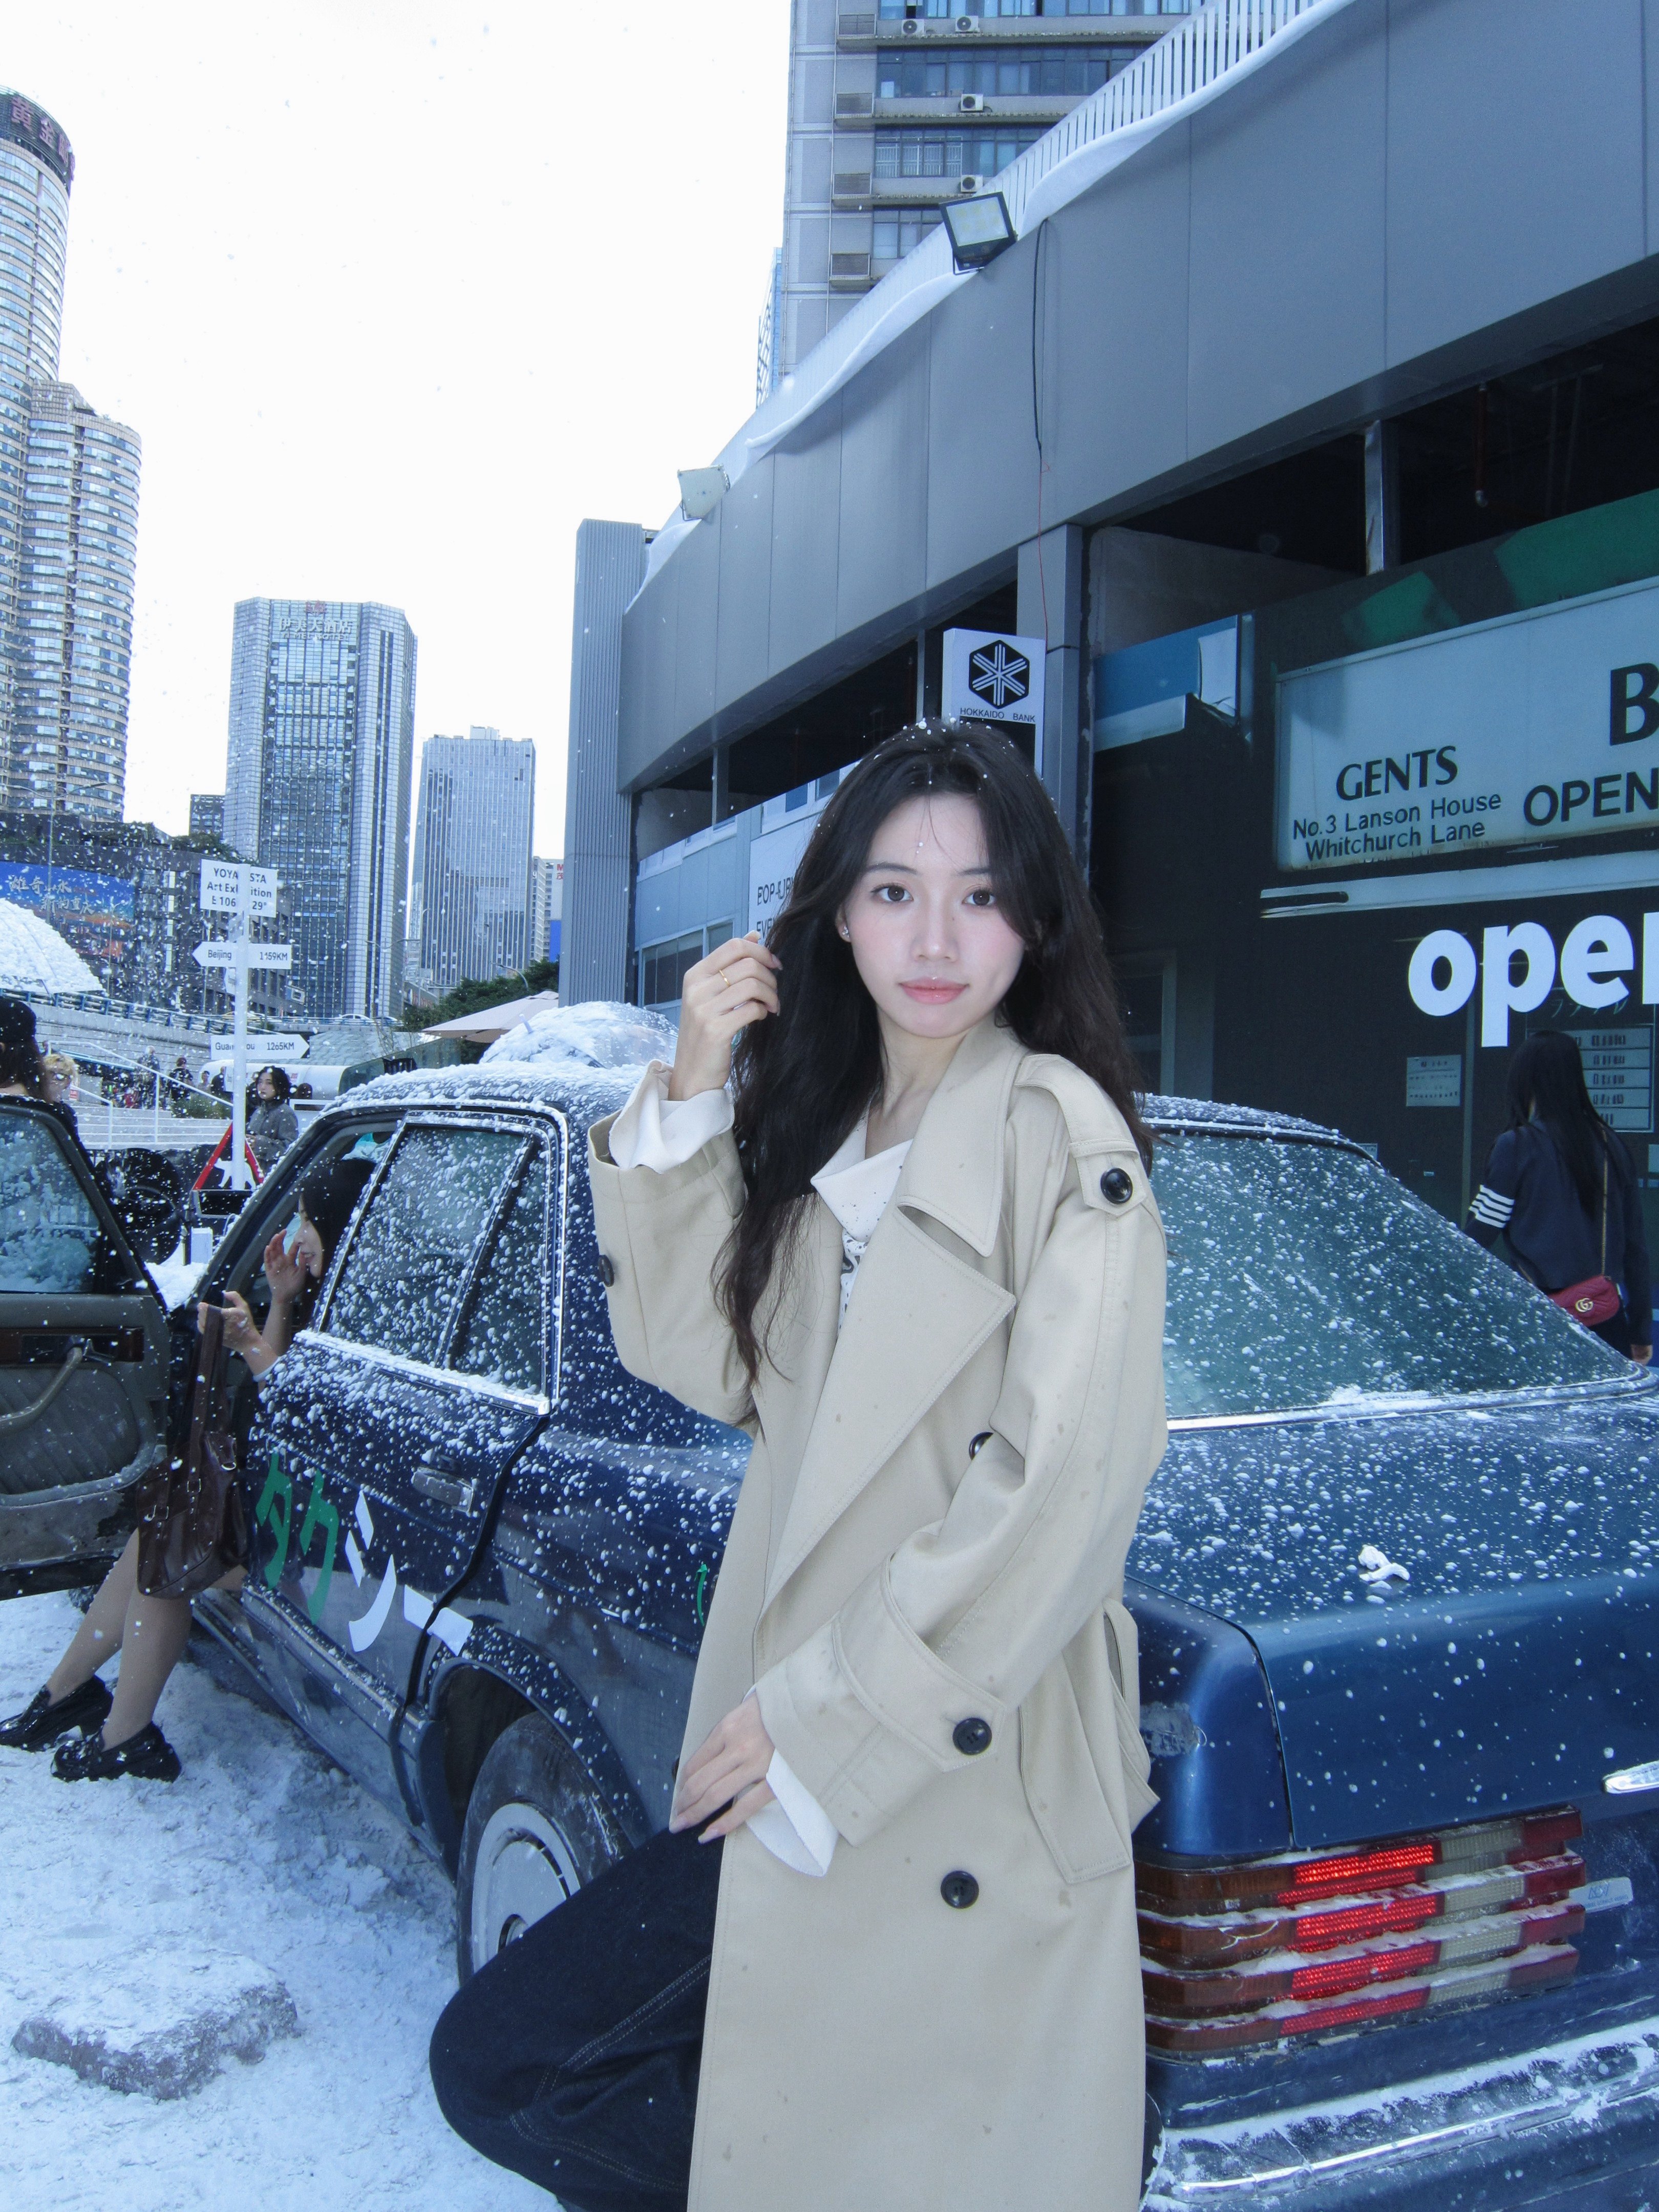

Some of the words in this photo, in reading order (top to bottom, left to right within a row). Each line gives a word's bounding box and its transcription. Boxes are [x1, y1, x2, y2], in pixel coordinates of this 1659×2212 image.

[960, 707, 1005, 719] HOKKAIDO
[1013, 713, 1035, 723] BANK
[1336, 746, 1458, 801] GENTS
[1293, 815, 1337, 840] No.3
[1346, 805, 1421, 832] Lanson
[1431, 793, 1501, 820] House
[1523, 768, 1659, 826] OPEN
[1305, 825, 1421, 861] Whitchurch
[1431, 821, 1486, 844] Lane
[207, 881, 222, 891] Art
[207, 949, 232, 961] Beijing
